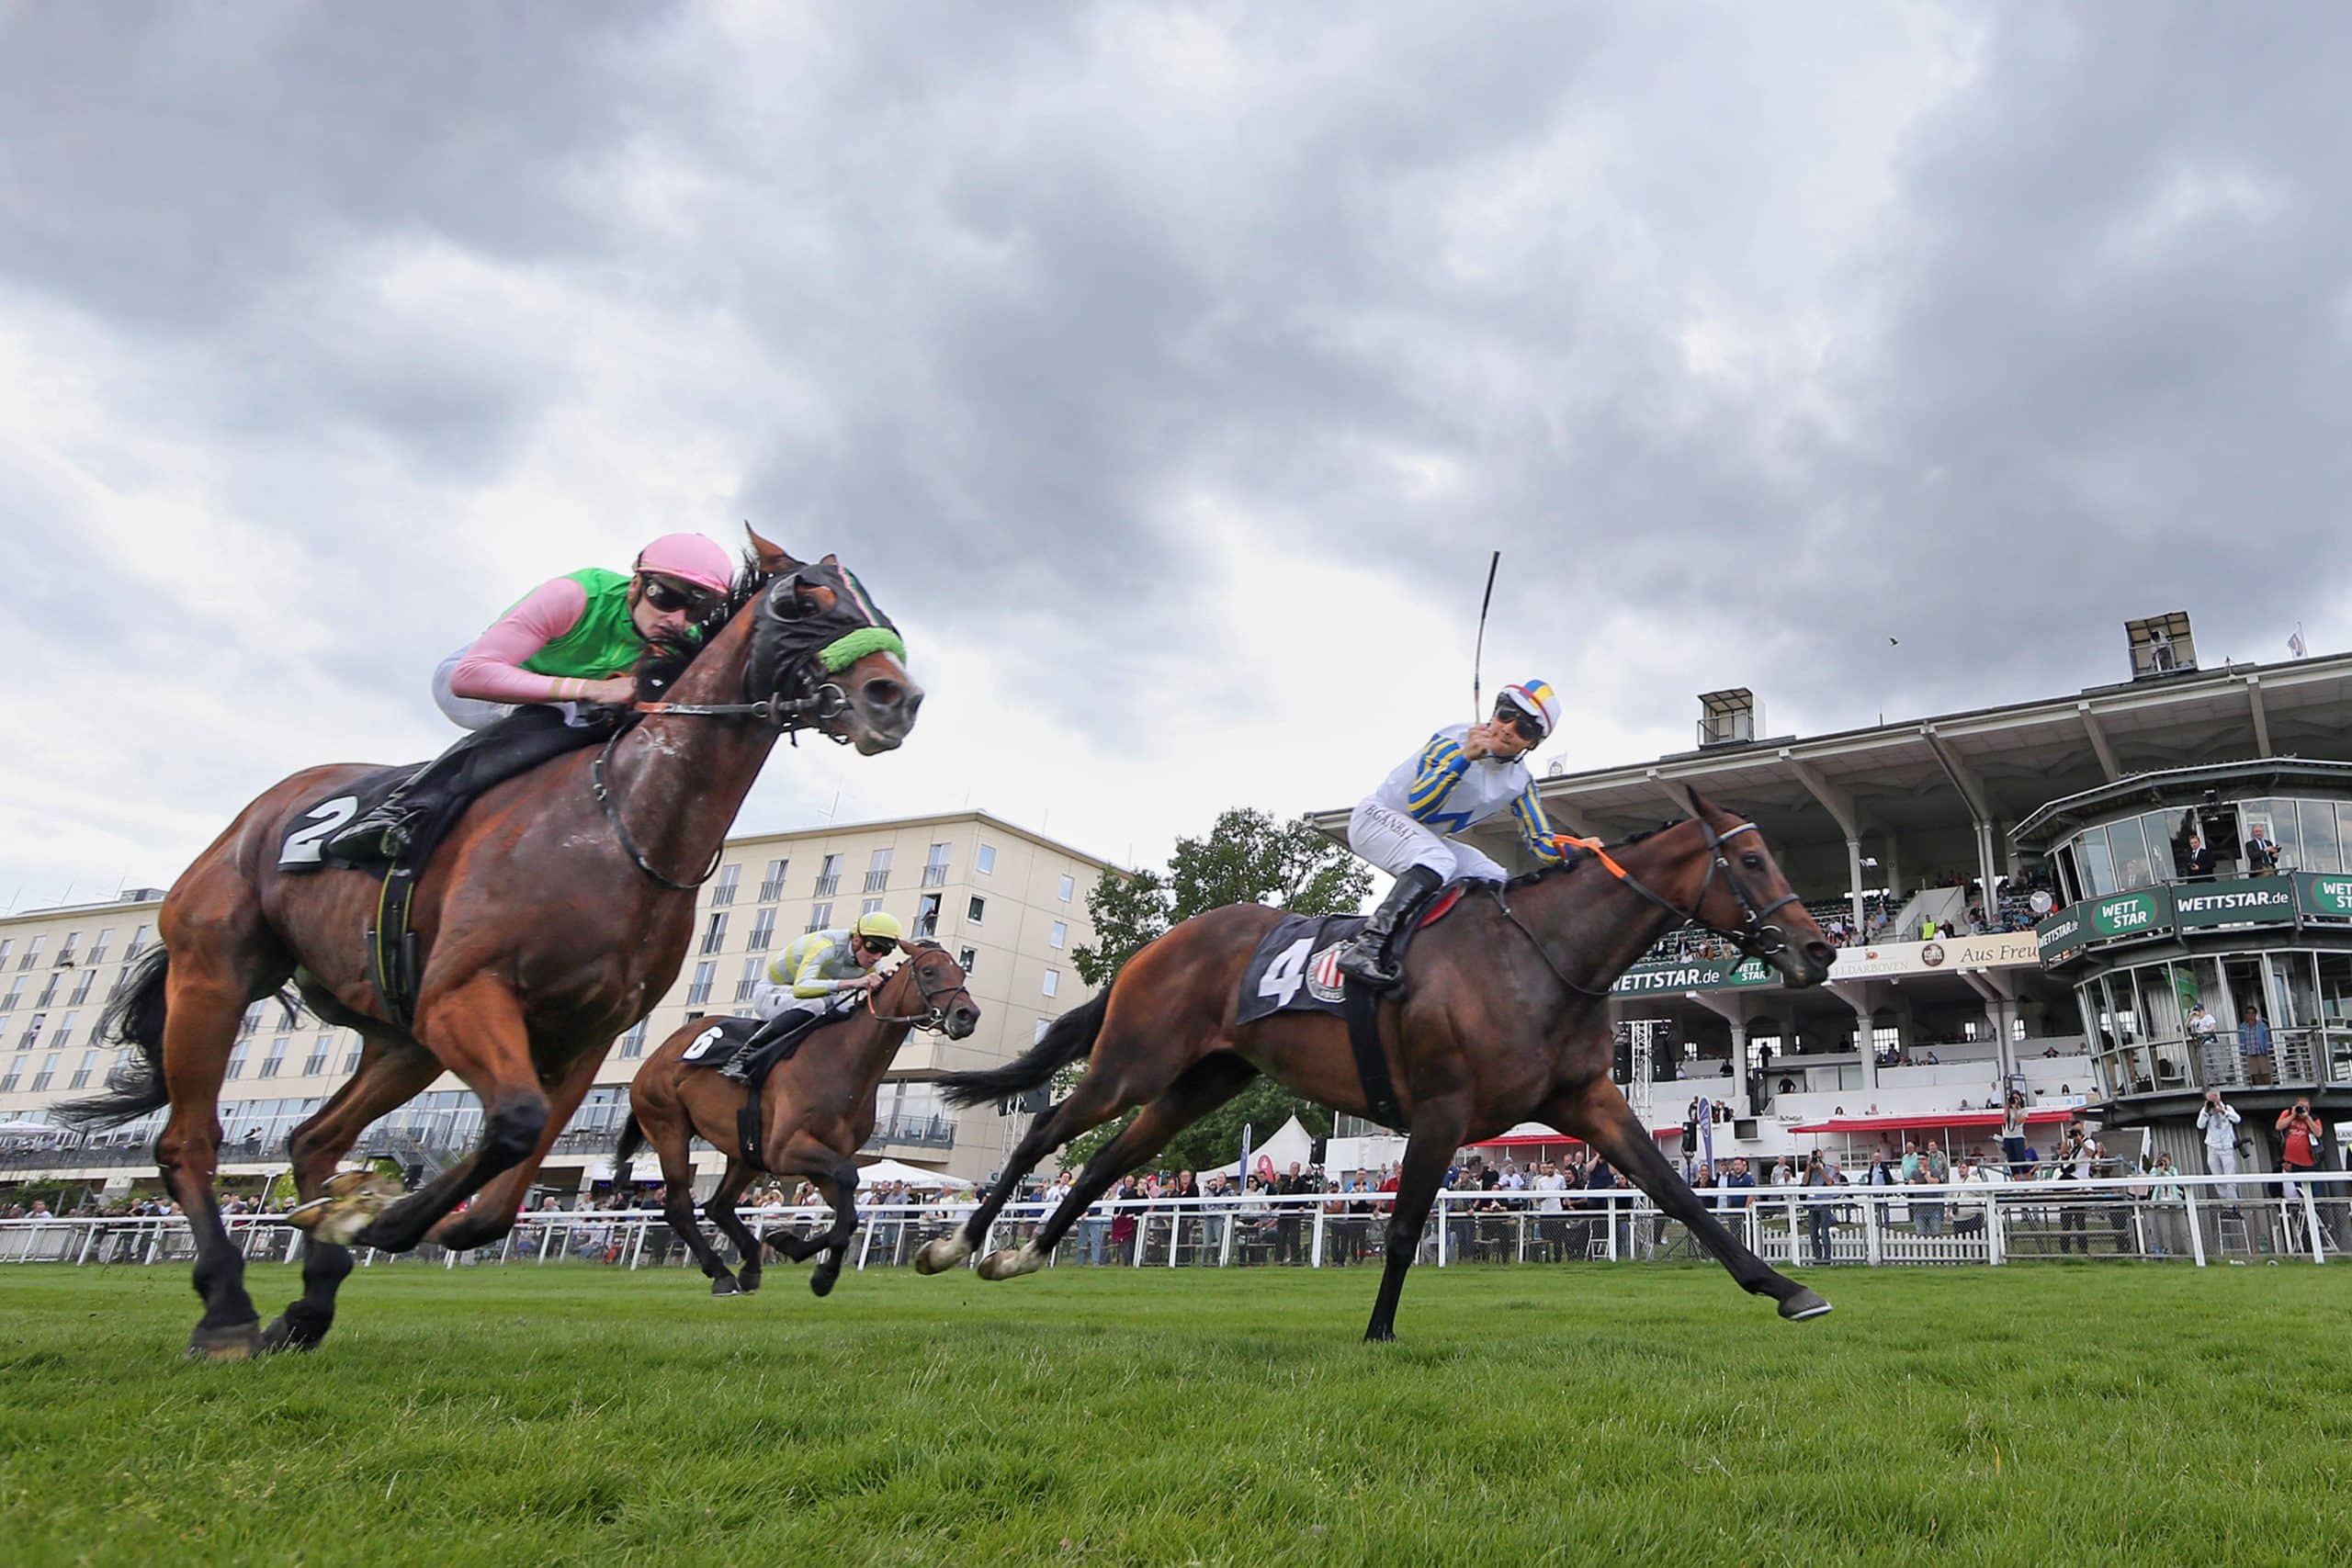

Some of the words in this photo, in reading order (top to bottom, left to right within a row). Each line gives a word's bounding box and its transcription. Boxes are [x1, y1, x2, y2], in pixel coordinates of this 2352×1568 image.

[278, 795, 358, 863] 2
[2102, 900, 2140, 919] WETT
[2177, 891, 2289, 912] WETTSTAR.de
[2113, 911, 2147, 929] STAR
[2039, 920, 2079, 949] WETTSTAR.de
[1961, 947, 1994, 964] Aus
[1258, 936, 1316, 1008] 4
[683, 1026, 724, 1060] 6
